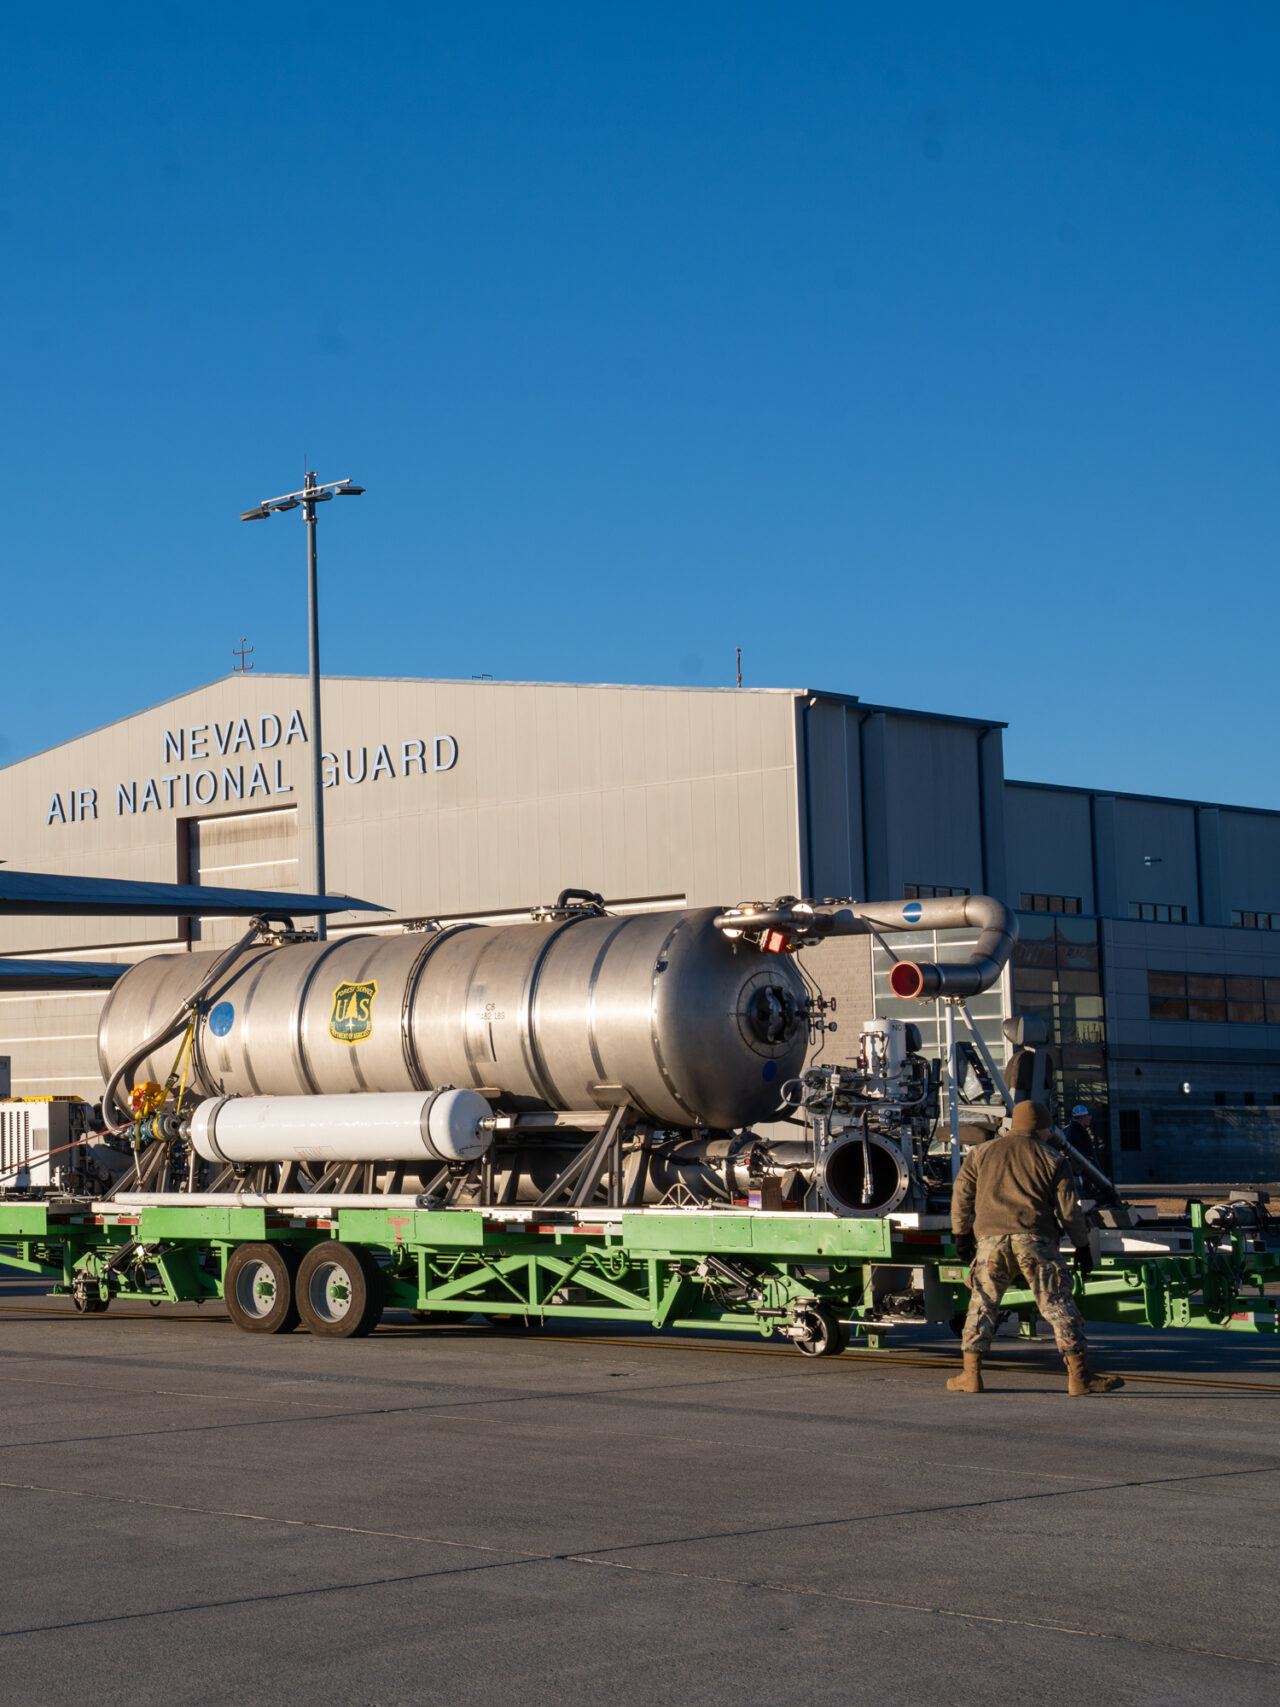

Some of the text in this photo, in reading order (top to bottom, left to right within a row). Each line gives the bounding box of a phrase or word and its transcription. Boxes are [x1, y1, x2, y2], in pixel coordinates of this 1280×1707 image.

[163, 709, 309, 763] NEVADA
[46, 734, 459, 825] AIR NATIONAL GUARD
